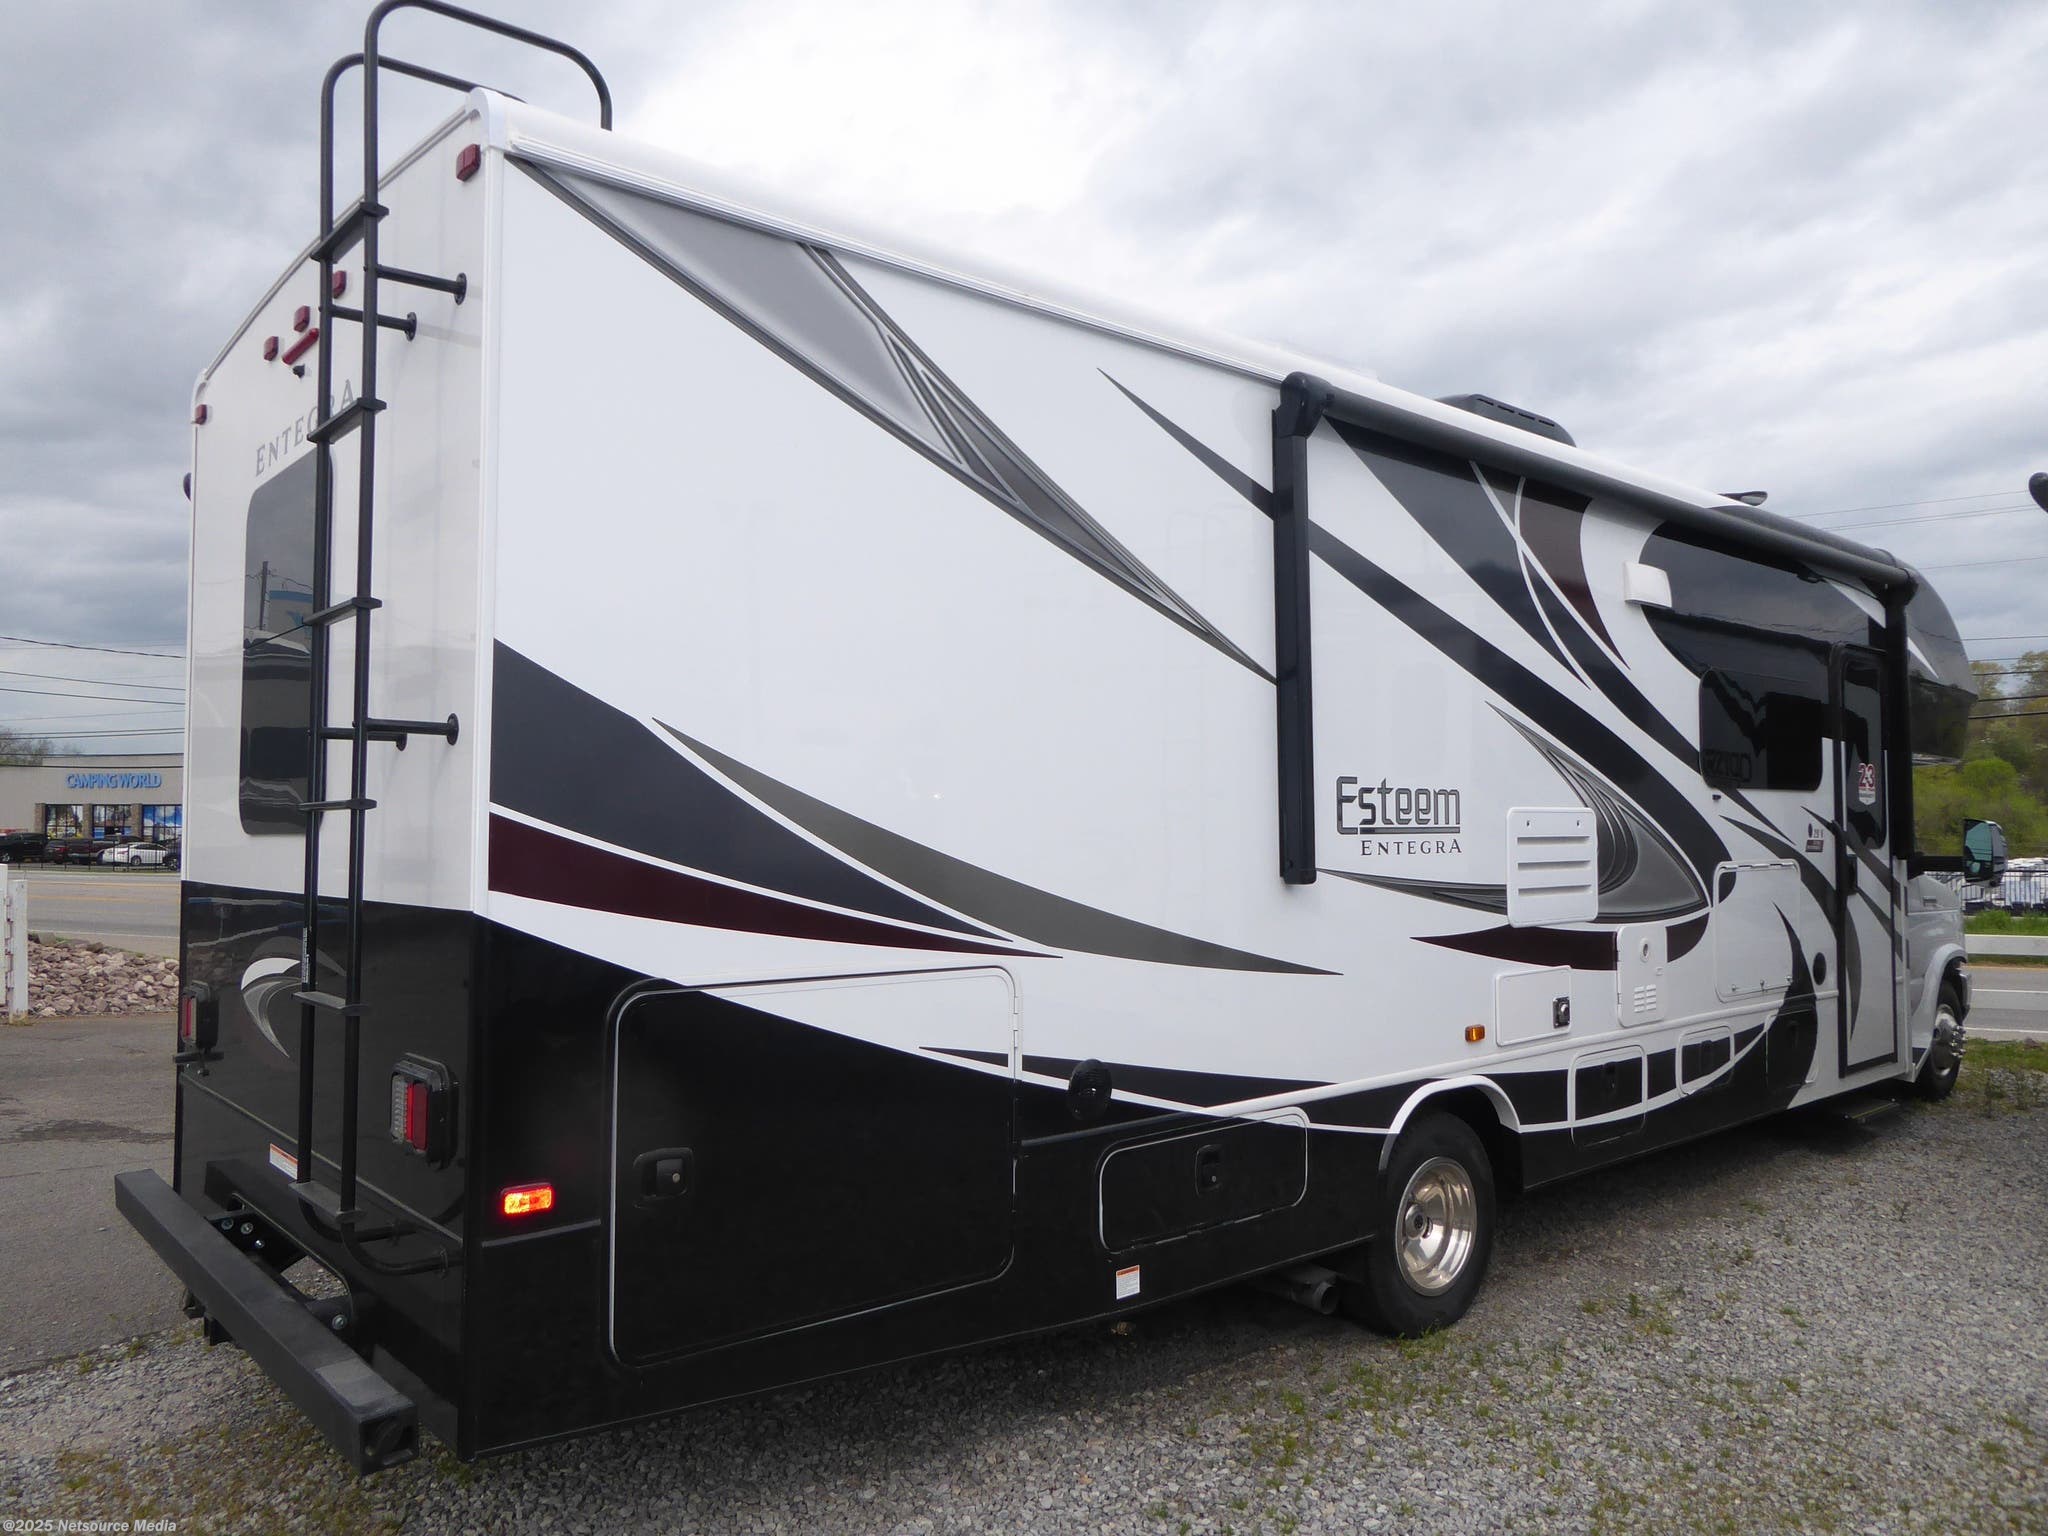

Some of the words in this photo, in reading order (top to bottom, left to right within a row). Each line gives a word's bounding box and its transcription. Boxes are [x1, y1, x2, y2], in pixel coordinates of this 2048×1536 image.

[67, 773, 118, 788] CAMPING
[119, 773, 163, 788] WORLD
[1336, 776, 1460, 835] Esteem
[1361, 838, 1462, 856] ENTEGRA
